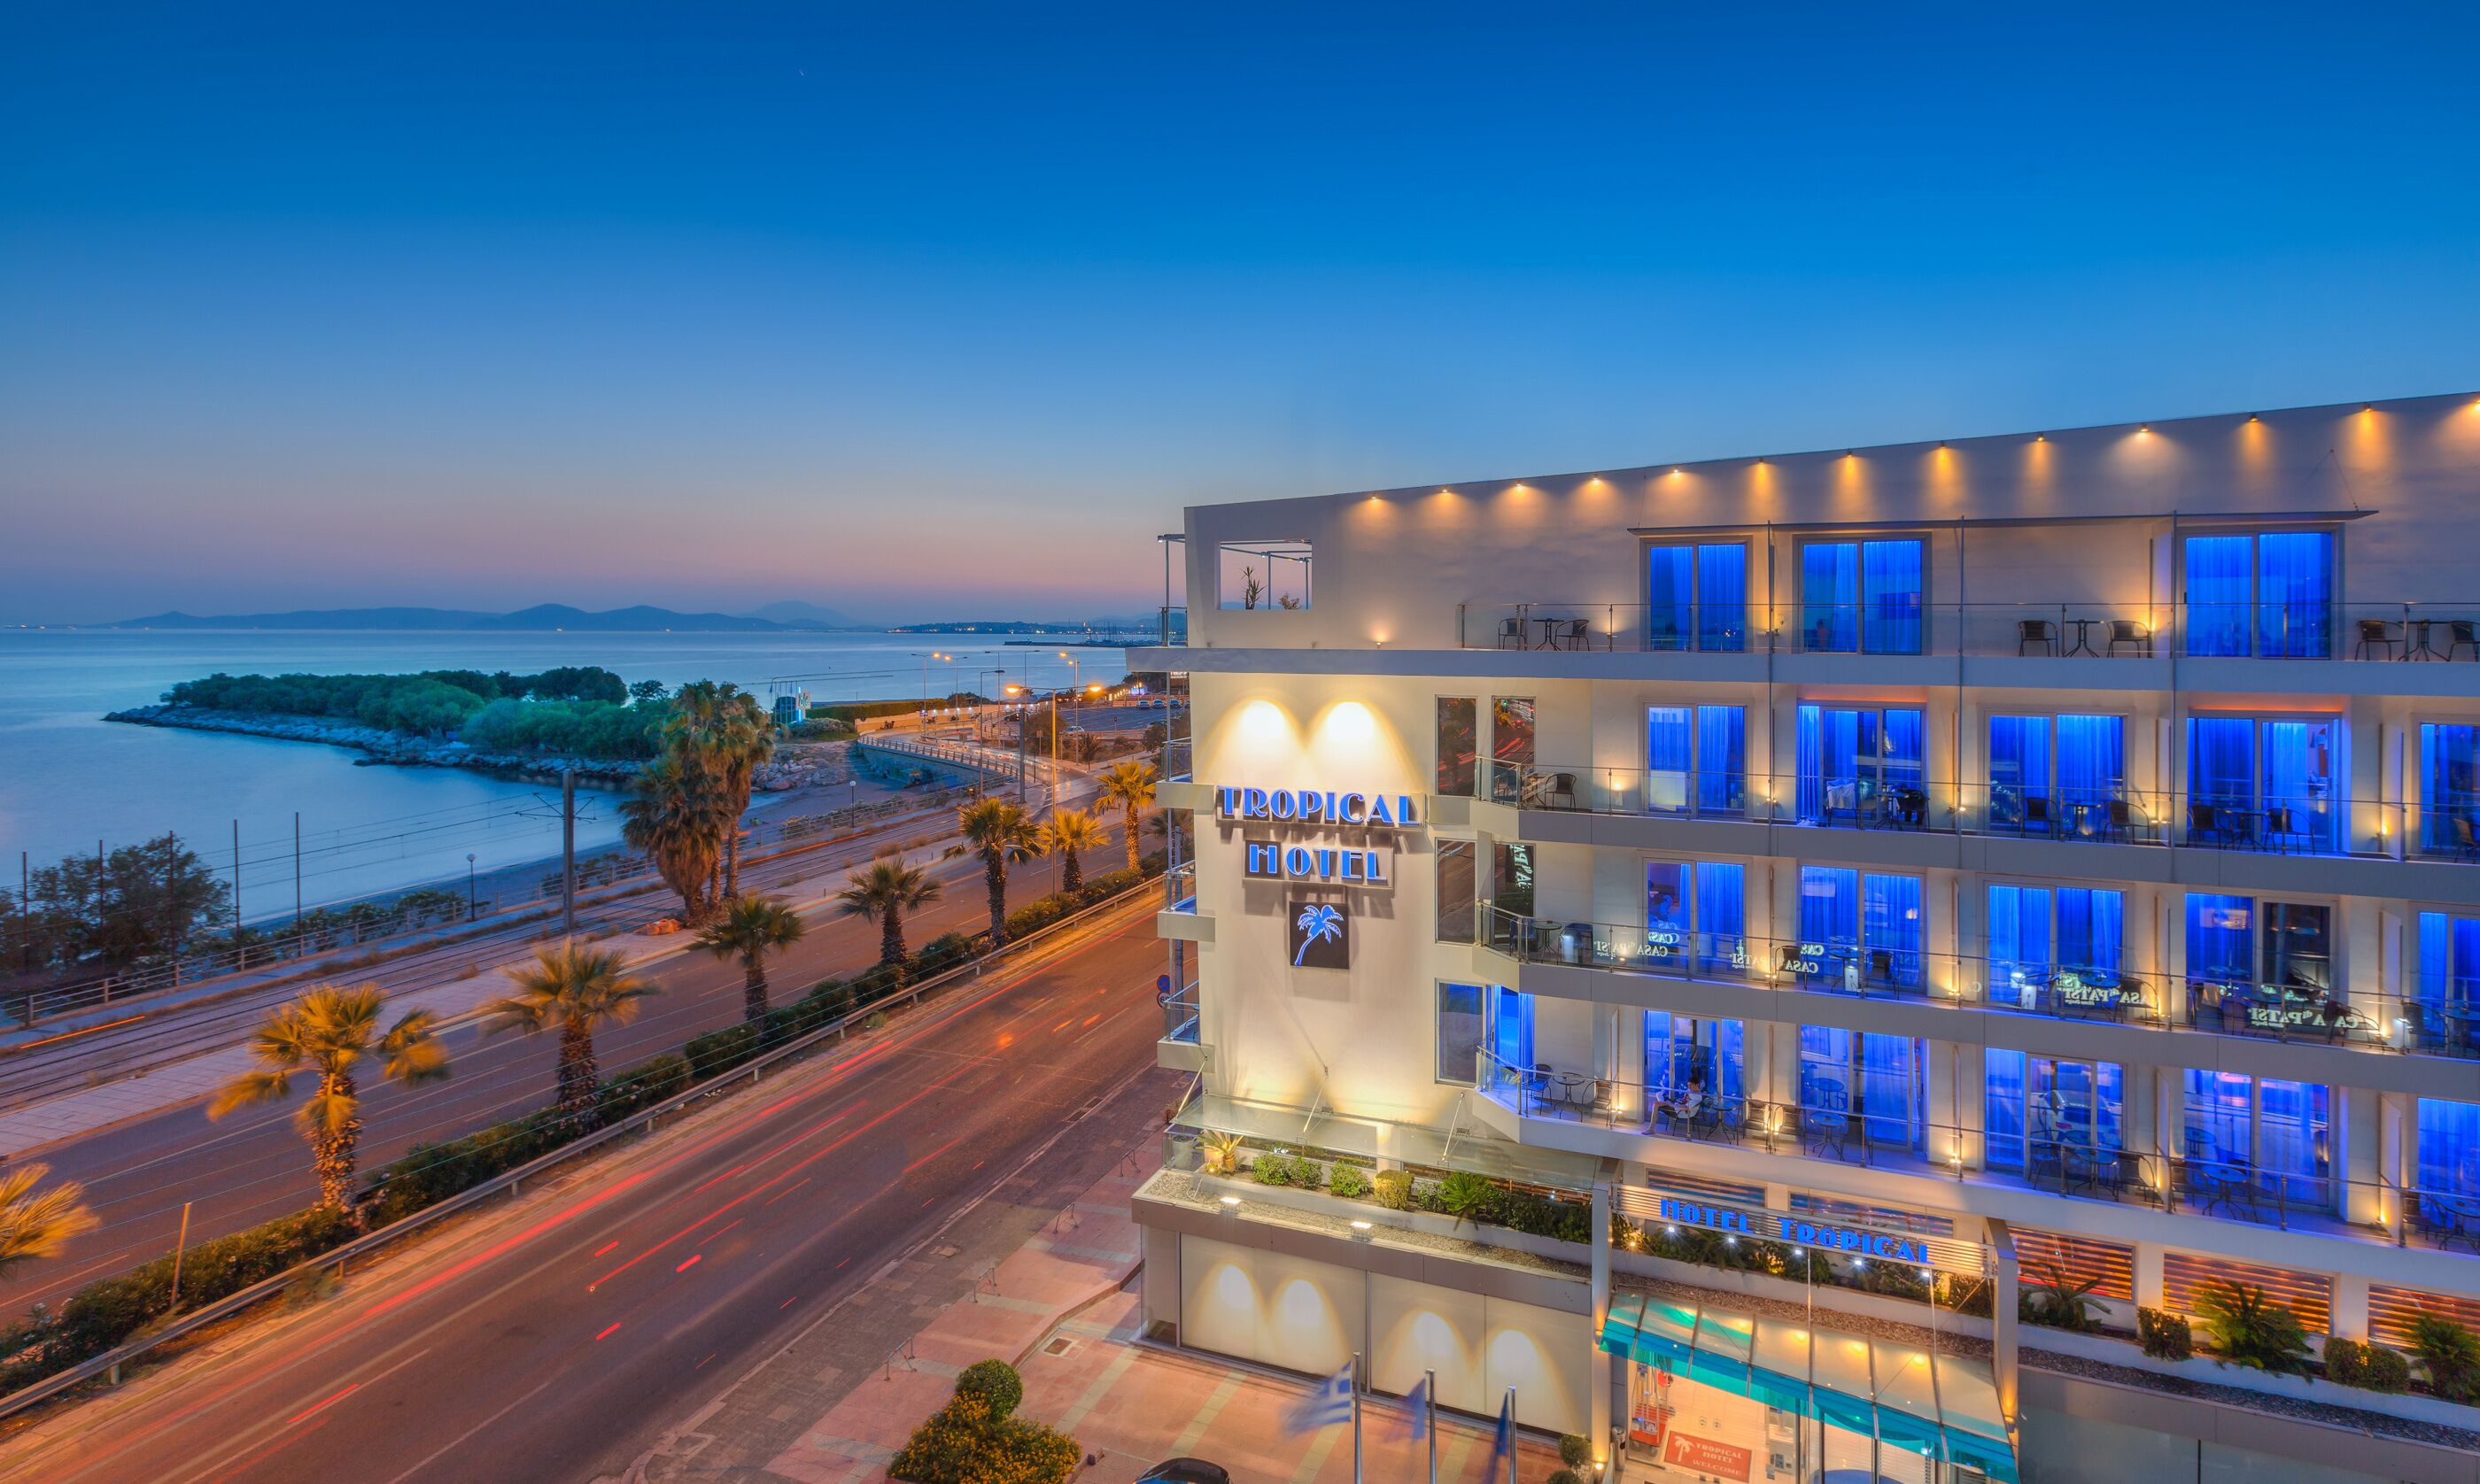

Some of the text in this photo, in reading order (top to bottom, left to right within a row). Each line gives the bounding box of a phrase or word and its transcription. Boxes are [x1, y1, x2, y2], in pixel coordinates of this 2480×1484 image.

[1217, 785, 1421, 825] TROPICAL
[1249, 844, 1387, 880] HOTEL
[1661, 1198, 1935, 1264] HOTEL TROPICAL
[1696, 1443, 1742, 1458] TROPICAL
[1702, 1451, 1733, 1464] HOTEL
[1693, 1458, 1742, 1476] WELCOME
